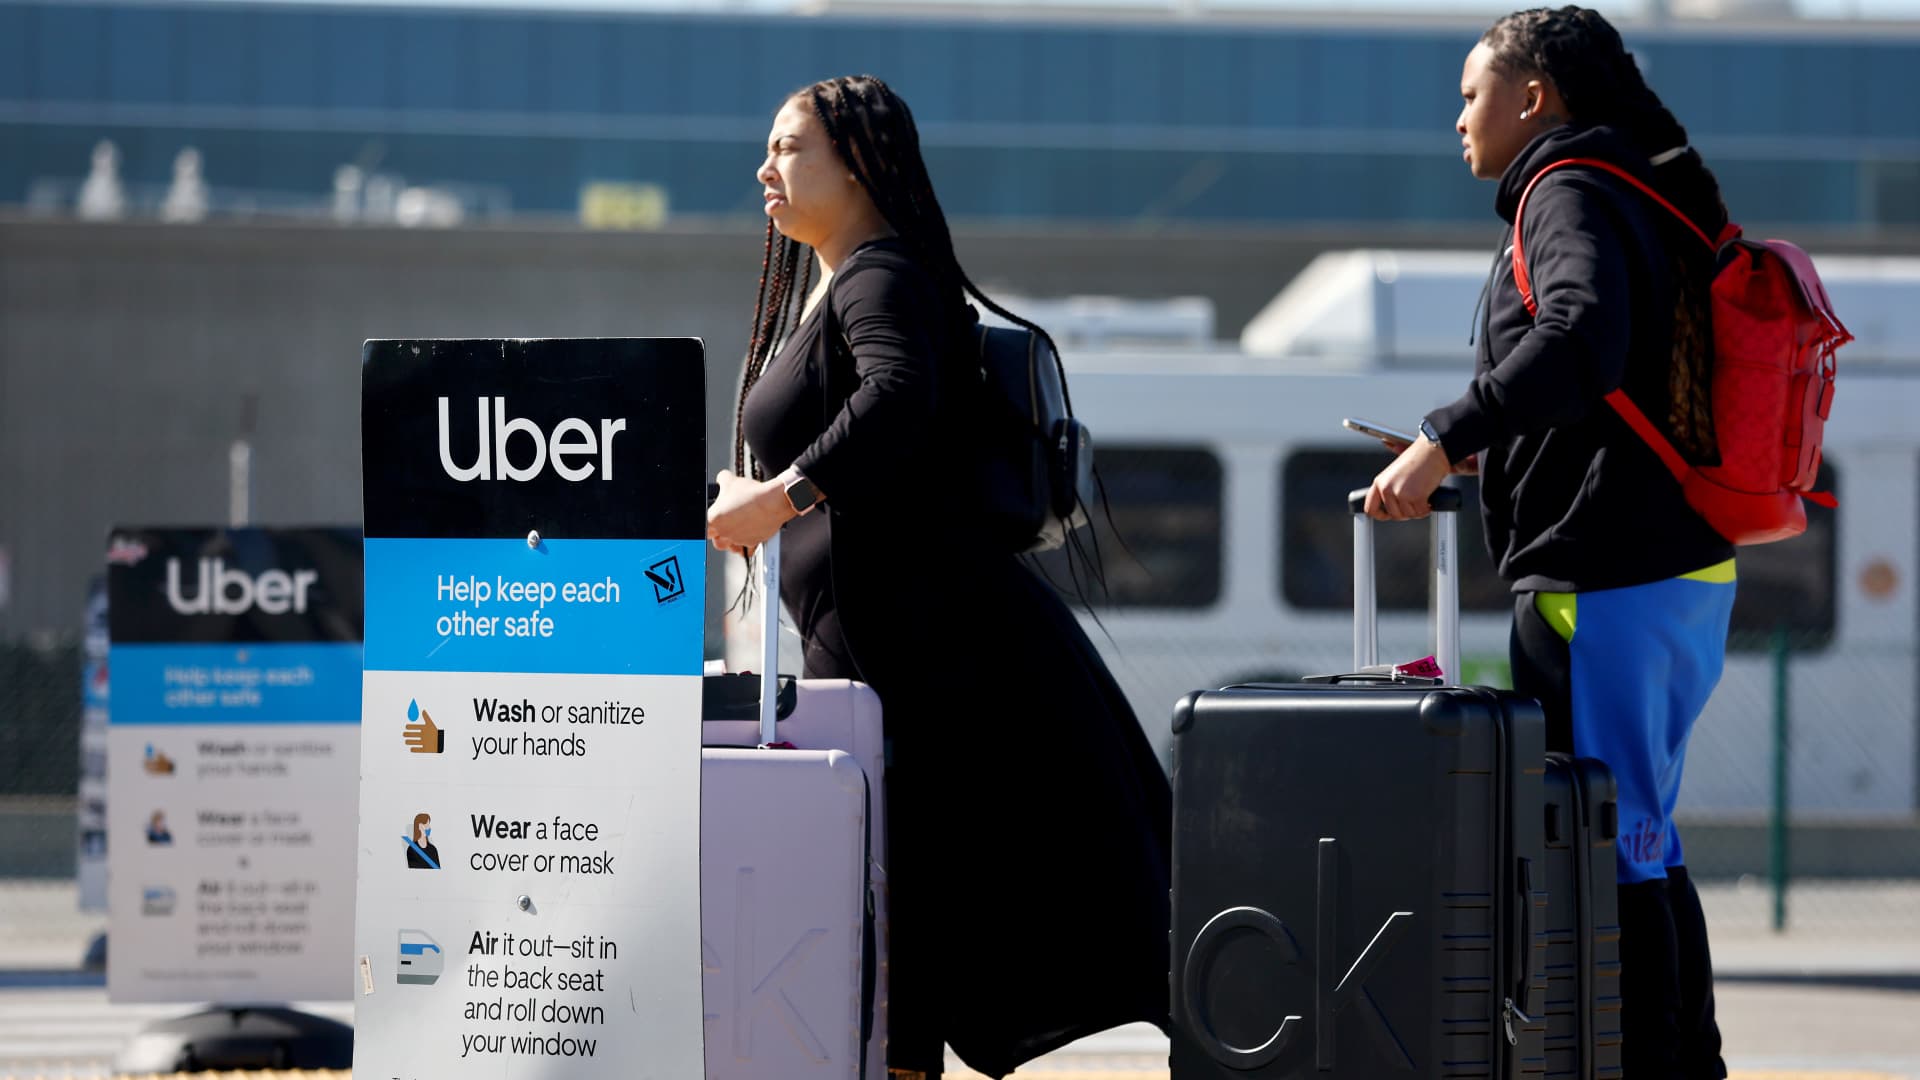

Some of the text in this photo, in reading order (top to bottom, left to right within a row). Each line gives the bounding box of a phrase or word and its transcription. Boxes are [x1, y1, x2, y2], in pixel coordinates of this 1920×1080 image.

[438, 396, 627, 482] Uber
[166, 556, 317, 615] Uber
[437, 574, 620, 610] Help keep each
[436, 609, 554, 638] other safe
[473, 697, 645, 725] Wash or sanitize
[471, 731, 586, 761] your hands
[470, 814, 599, 842] Wear a face
[470, 850, 615, 875] cover or mask
[468, 930, 617, 960] Air it out—sit in
[467, 963, 605, 992] the back seat
[464, 996, 604, 1025] and roll down
[461, 1031, 597, 1058] your window
